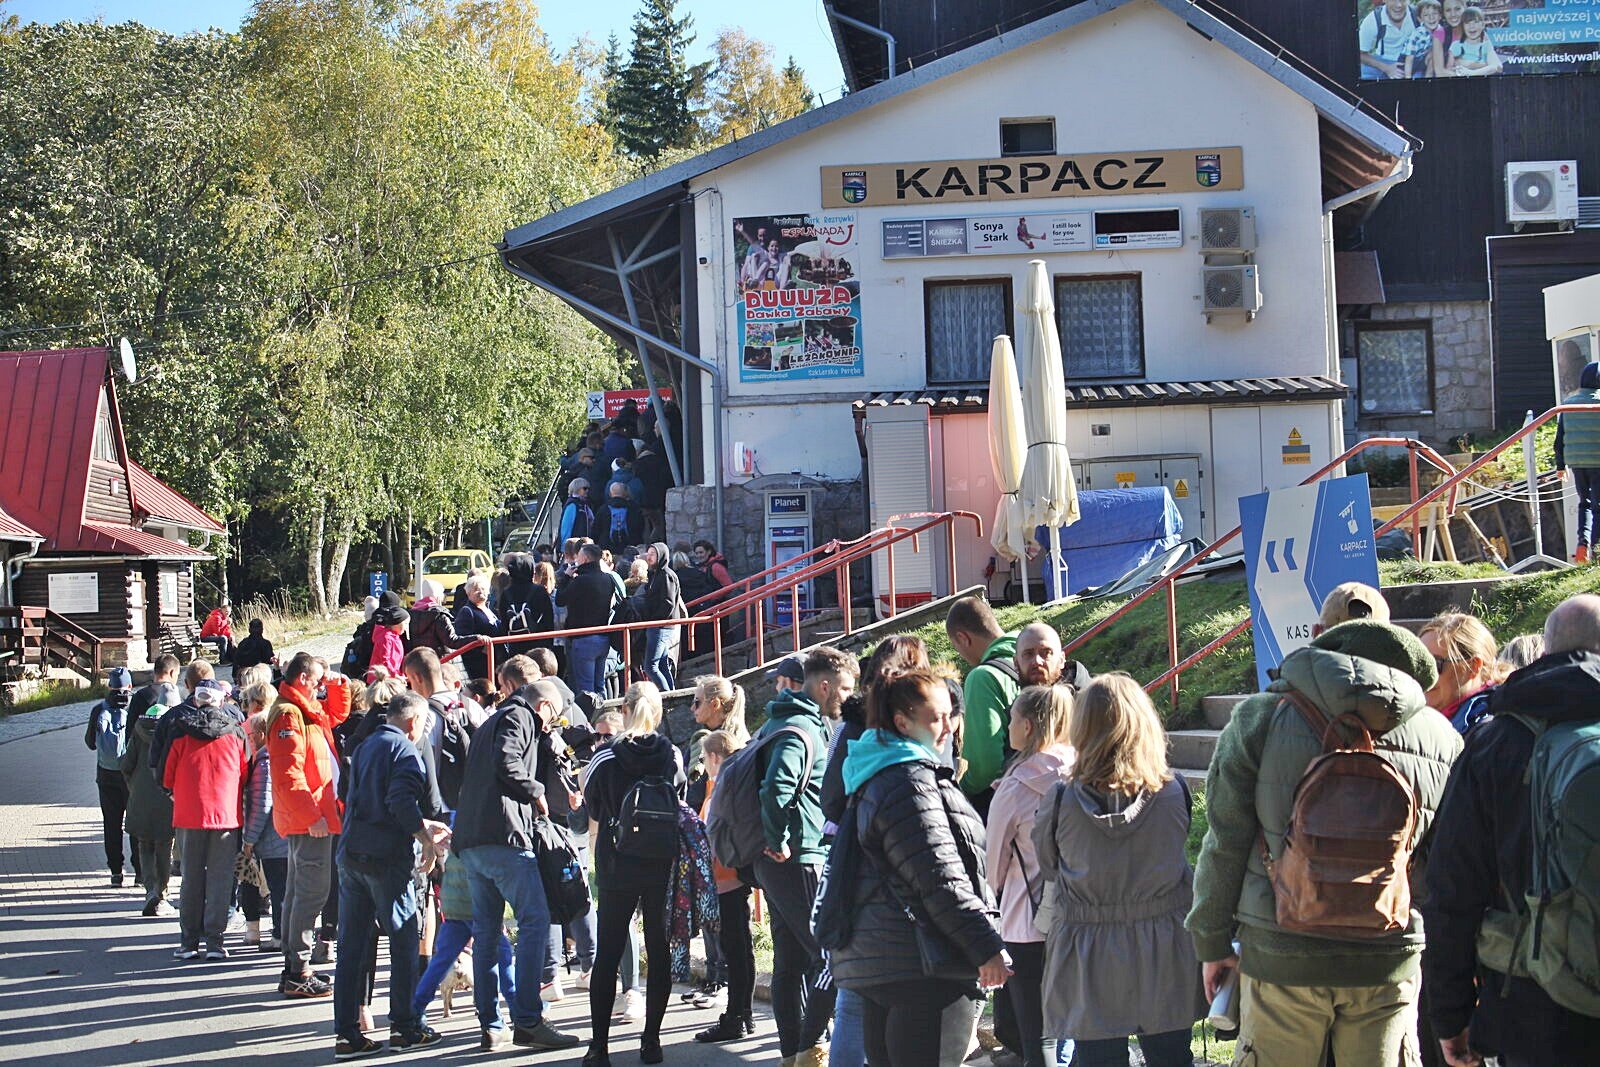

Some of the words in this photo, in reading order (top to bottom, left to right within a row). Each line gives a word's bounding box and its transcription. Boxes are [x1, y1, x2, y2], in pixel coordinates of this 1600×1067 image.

[1516, 10, 1590, 25] najwyższej
[1493, 28, 1566, 42] widokowej
[1570, 30, 1581, 39] w
[896, 157, 1167, 200] KARPACZ
[781, 226, 845, 238] ESPLANADA
[928, 227, 964, 236] KARPACZ
[973, 222, 1004, 232] Sonya
[983, 232, 1009, 242] Stark
[744, 285, 852, 309] DUUUŻA
[746, 308, 791, 320] Dawka
[795, 306, 851, 317] Zabawy
[774, 498, 800, 507] Planet
[1340, 539, 1368, 552] KARPACZ
[374, 574, 382, 598] TOAL
[1286, 624, 1313, 640] KAS
